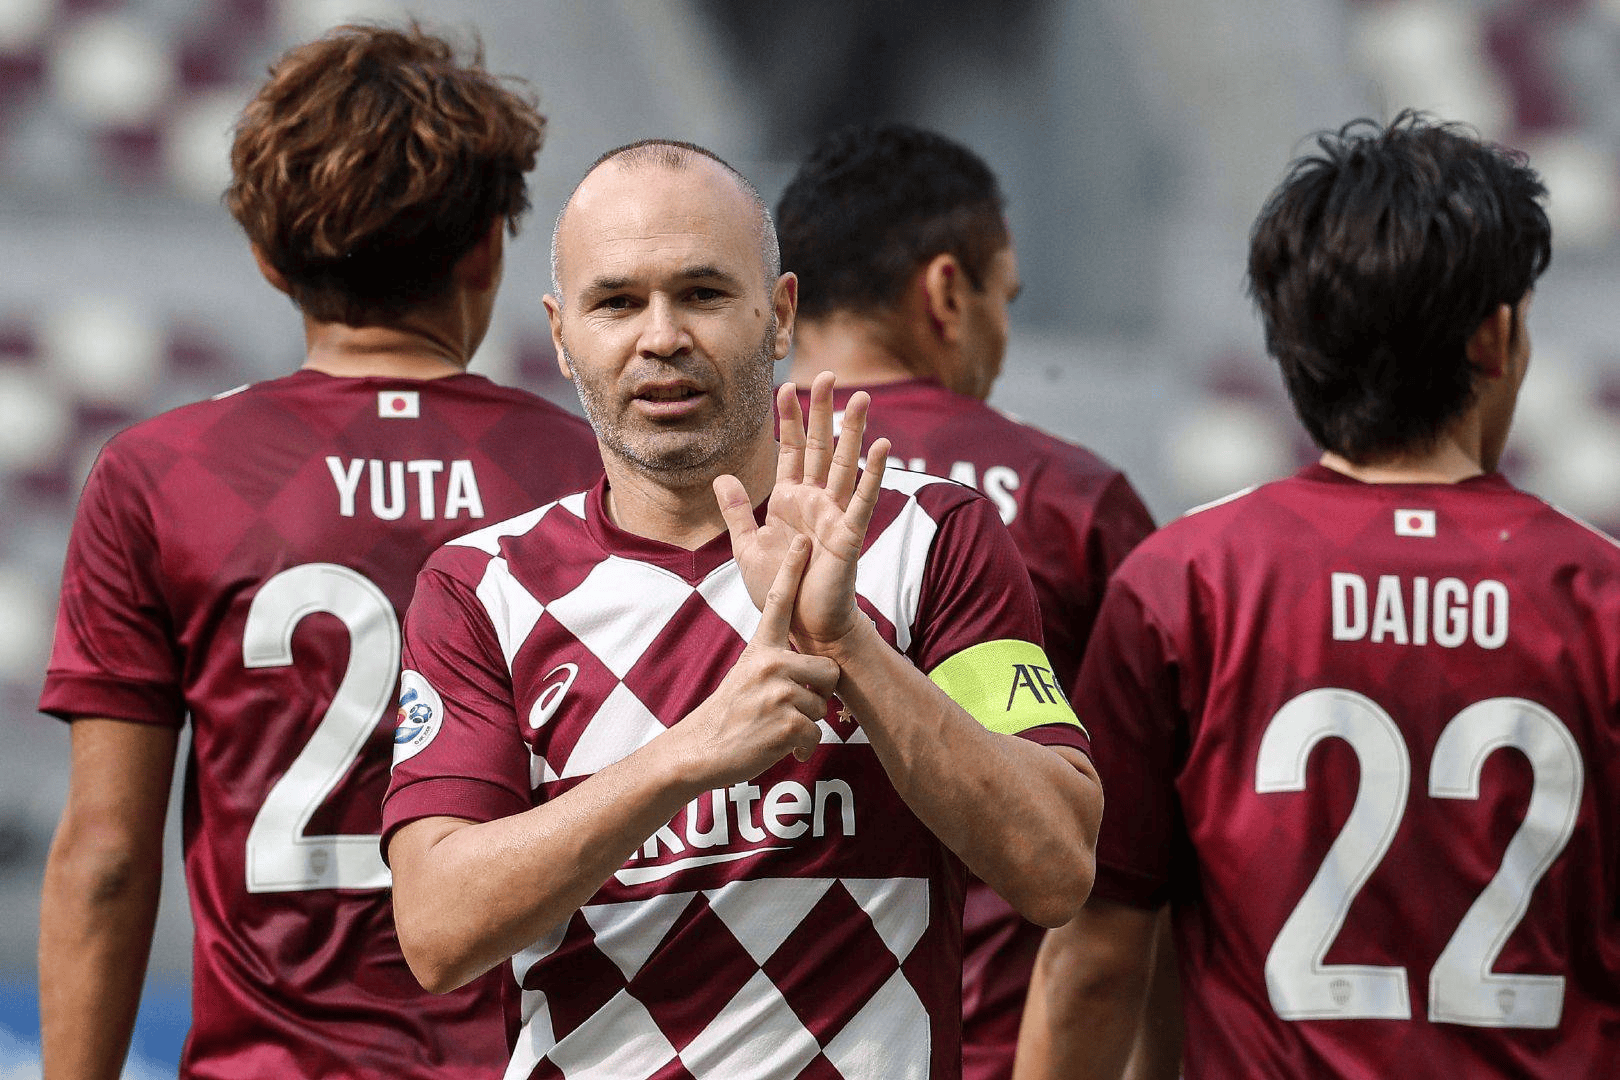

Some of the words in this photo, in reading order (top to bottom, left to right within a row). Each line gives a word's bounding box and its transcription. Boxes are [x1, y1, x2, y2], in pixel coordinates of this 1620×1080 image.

[325, 456, 484, 521] YUTA
[1330, 571, 1510, 650] DAIGO
[242, 562, 401, 893] 2
[1006, 664, 1069, 712] AF
[1254, 687, 1584, 1029] 22
